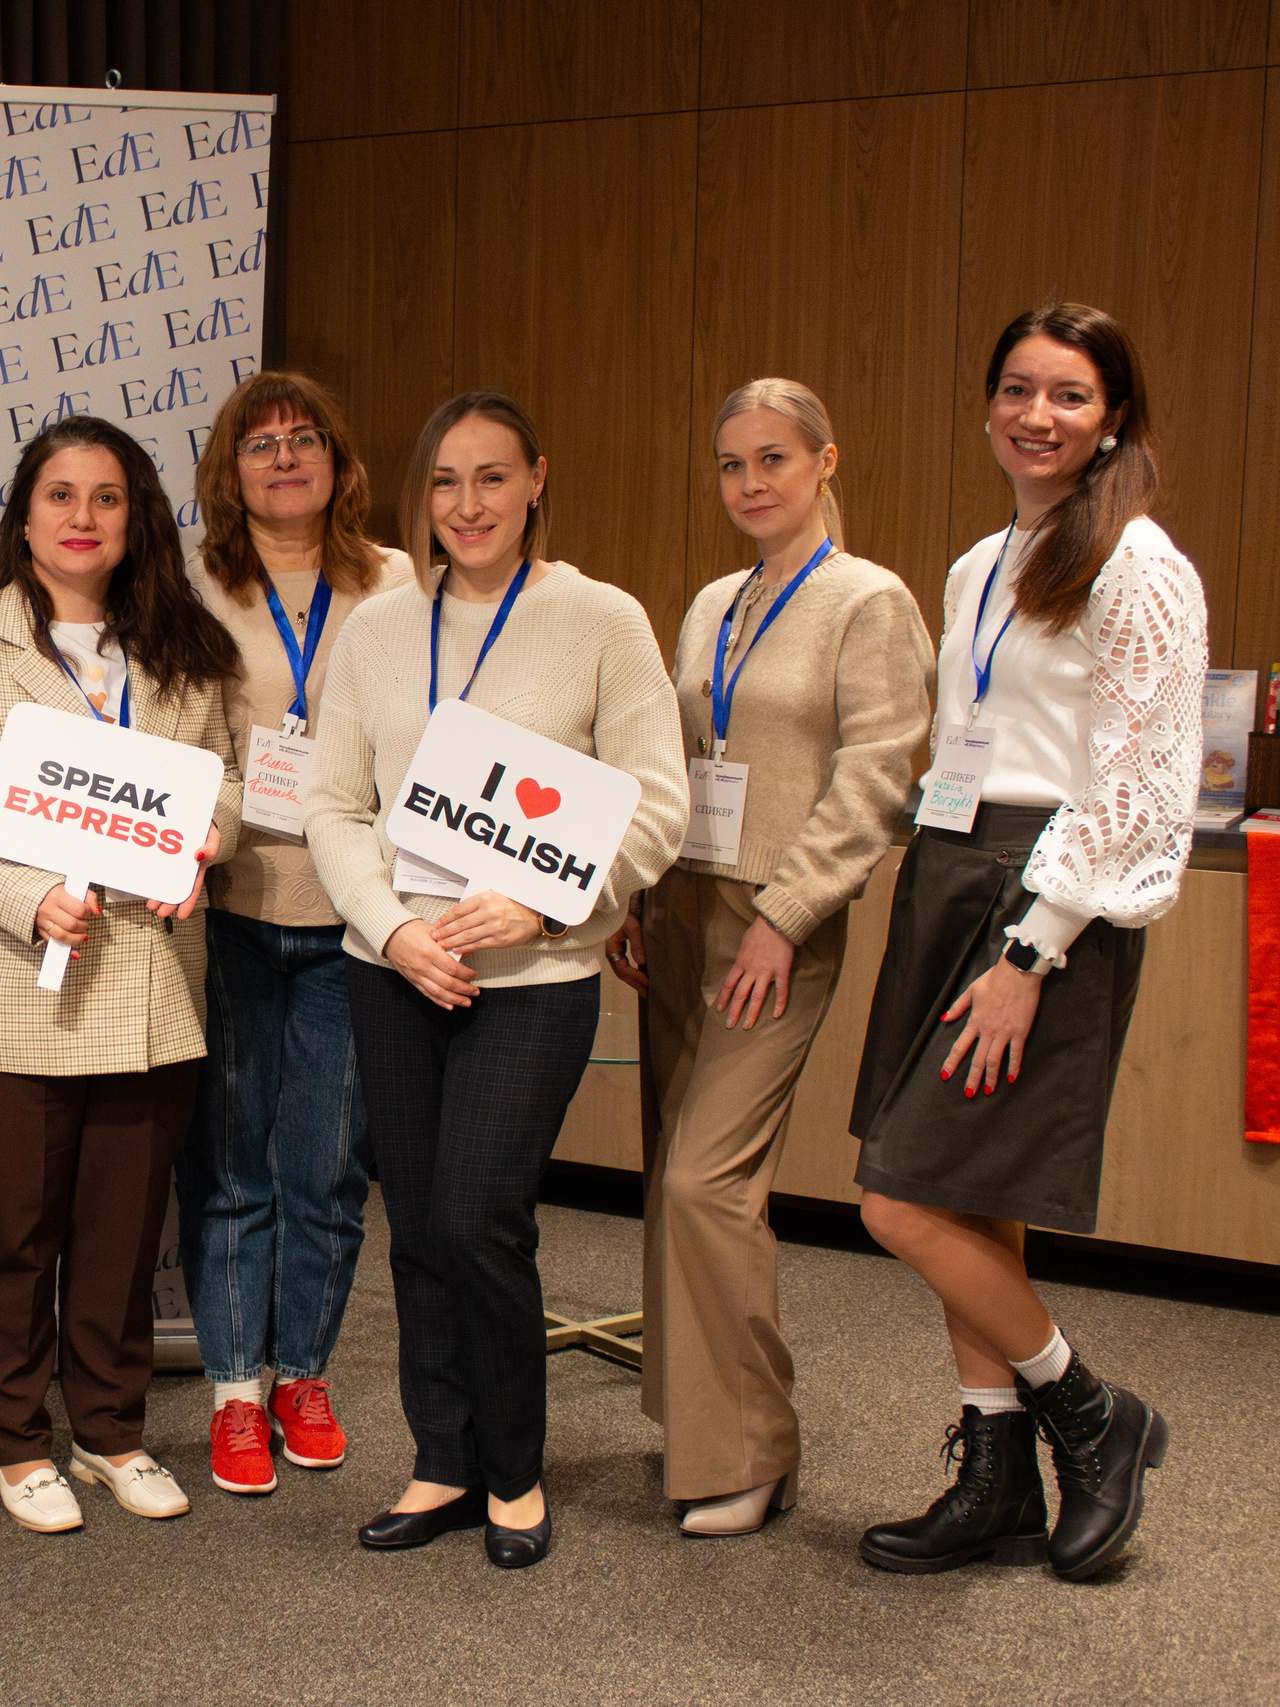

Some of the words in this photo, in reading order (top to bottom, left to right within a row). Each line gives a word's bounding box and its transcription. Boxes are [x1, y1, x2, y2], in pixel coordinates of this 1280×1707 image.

[70, 132, 160, 184] EdE
[184, 111, 273, 161] EdE
[25, 203, 116, 255] EdE
[138, 180, 228, 232] EdE
[94, 250, 184, 302] EdE
[206, 228, 263, 279] Ed
[50, 320, 140, 373] EdE
[162, 297, 250, 349] EdE
[119, 367, 208, 419] EdE
[38, 760, 171, 817] SPEAK
[258, 772, 299, 788] СПИКЕР
[480, 762, 506, 802] I
[940, 770, 976, 784] СПИКЕР
[4, 785, 184, 854] EXPRESS
[404, 782, 596, 891] ENGLISH
[695, 804, 734, 818] СПИКЕР
